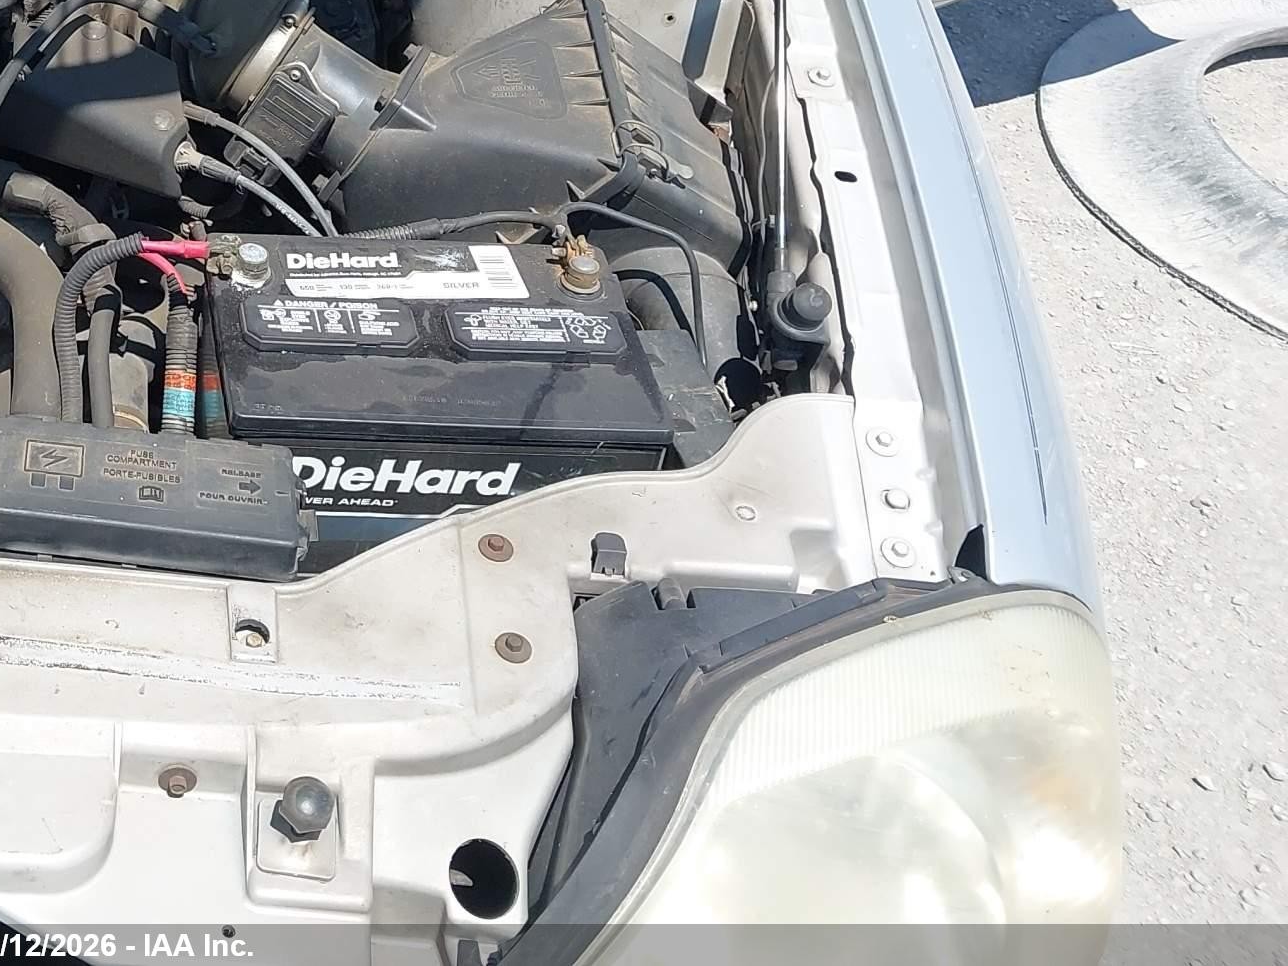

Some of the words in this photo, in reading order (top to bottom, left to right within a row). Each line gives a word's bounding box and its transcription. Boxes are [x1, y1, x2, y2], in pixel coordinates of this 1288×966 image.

[286, 252, 399, 269] DieHard
[443, 281, 479, 289] SILVER
[284, 300, 328, 308] DANGER
[130, 449, 154, 459] FUSE
[107, 455, 177, 469] COMPARTMENT
[103, 468, 181, 483] PORTE-FUSIBLES
[221, 468, 262, 478] RELEASE
[292, 456, 521, 496] DieHard
[199, 492, 225, 501] POUR
[304, 497, 334, 505] VER
[338, 498, 394, 507] AHEAD
